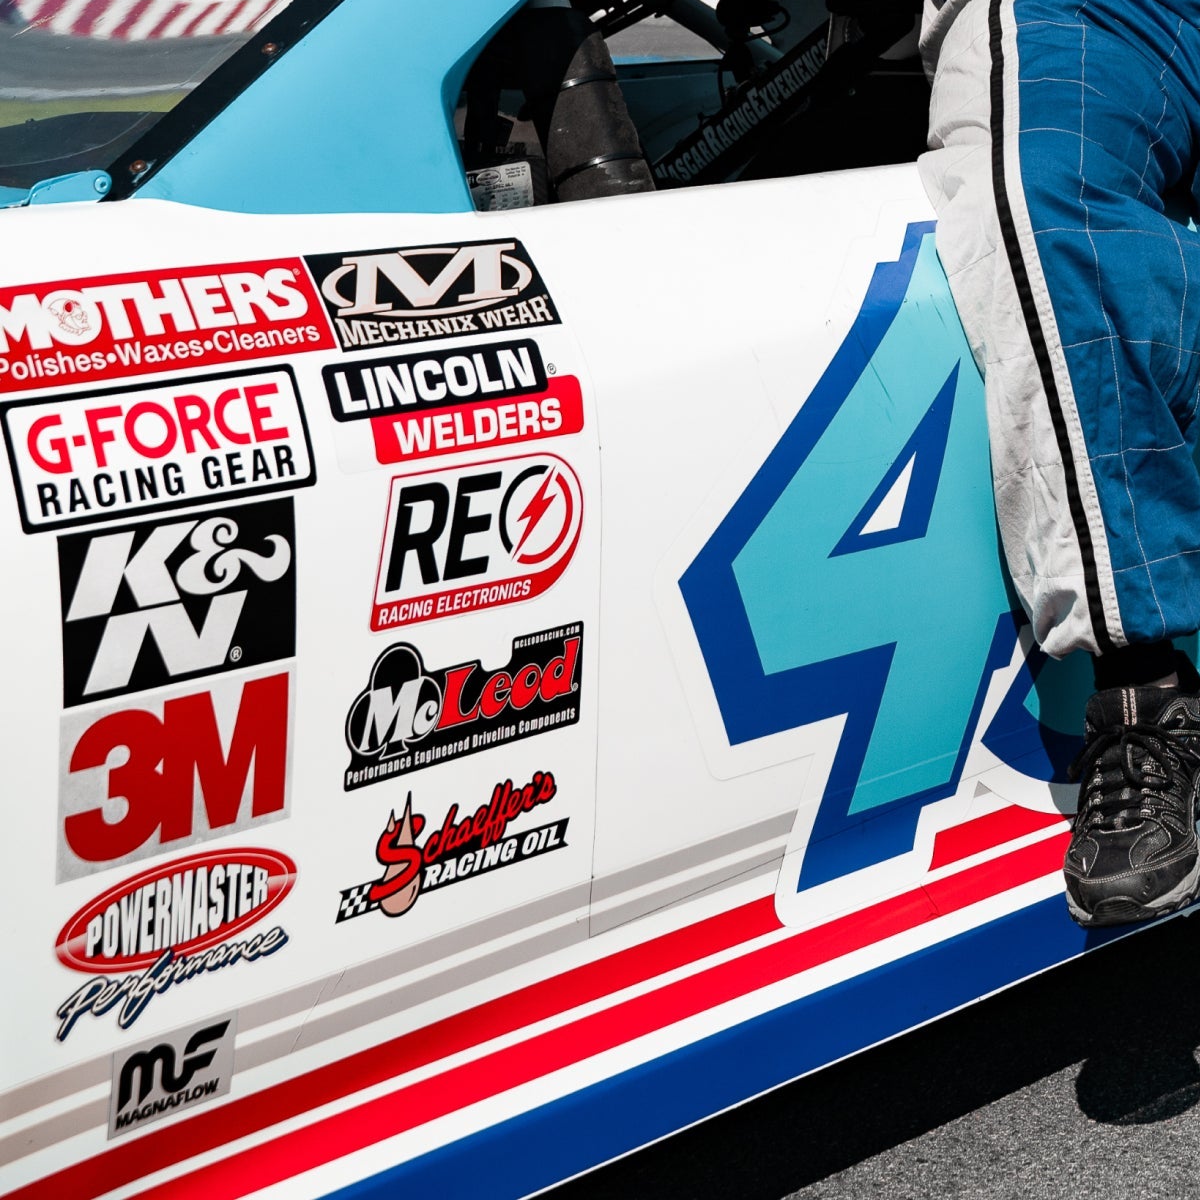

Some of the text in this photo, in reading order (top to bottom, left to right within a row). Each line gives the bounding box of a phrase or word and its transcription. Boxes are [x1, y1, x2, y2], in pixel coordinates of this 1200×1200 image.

[0, 268, 309, 353] MOTHERS
[335, 297, 554, 348] MECHANIX WEAR
[334, 347, 537, 414] LINCOLN
[27, 383, 290, 474] G-FORCE
[393, 397, 563, 455] WELDERS
[37, 444, 297, 517] RACING GEAR
[378, 579, 532, 626] RACING ELECTRONICS
[514, 625, 581, 649] MCLEODRACING.COM
[358, 636, 581, 752] McLeod
[63, 672, 290, 863] 3M
[346, 707, 576, 786] Performance Engineered Driveline Components
[369, 772, 556, 901] Schaeffer's
[422, 825, 560, 889] RACING OIL
[84, 863, 269, 959] POWERMASTER
[56, 927, 289, 1041] Performance
[115, 1078, 220, 1130] MAGNAFLOW
